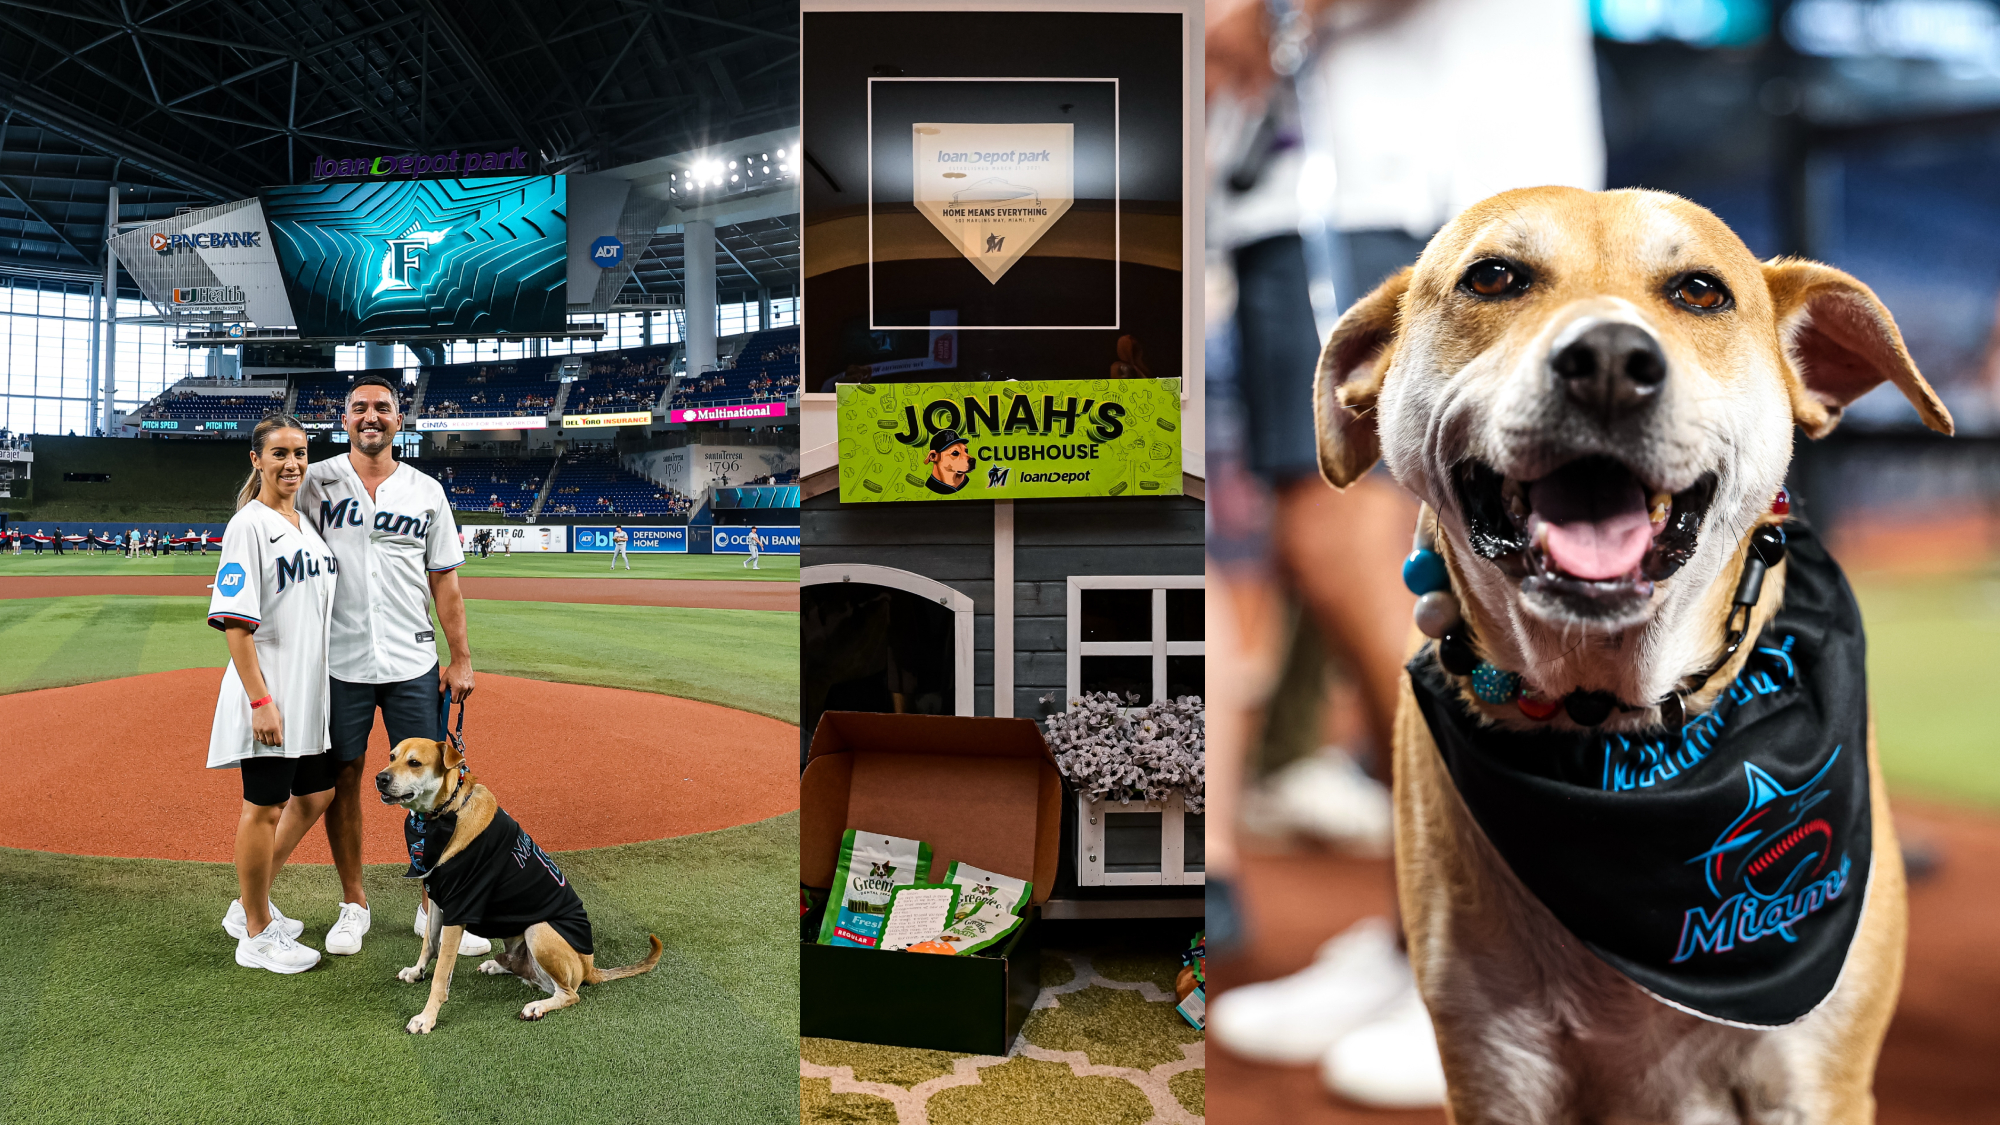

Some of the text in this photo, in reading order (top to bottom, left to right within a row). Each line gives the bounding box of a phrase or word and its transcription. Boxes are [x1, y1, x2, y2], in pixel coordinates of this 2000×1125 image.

[314, 147, 528, 178] loanDepot park
[937, 150, 1051, 165] loanDepot park
[942, 208, 1048, 217] HOME MEANS EVERYTHING
[170, 231, 260, 249] PNCBANK
[594, 245, 620, 258] ADT
[386, 238, 429, 291] F
[229, 326, 242, 335] 42
[697, 405, 771, 421] Multinational
[142, 420, 160, 429] PITCH
[160, 421, 178, 429] SPEED
[205, 421, 238, 430] PITCH TYPE
[580, 417, 601, 425] TORO
[603, 416, 649, 424] INSURANCE
[894, 394, 1126, 446] JONAH'S
[977, 443, 1100, 462] CLUBHOUSE
[1020, 470, 1091, 484] loanDepot
[511, 528, 525, 538] GO.
[633, 531, 683, 539] DEFENDING
[633, 539, 660, 547] HOME
[730, 535, 769, 546] OCEN
[220, 573, 242, 586] ADT
[1670, 850, 1851, 963] Miami
[837, 929, 868, 944] REGULAR
